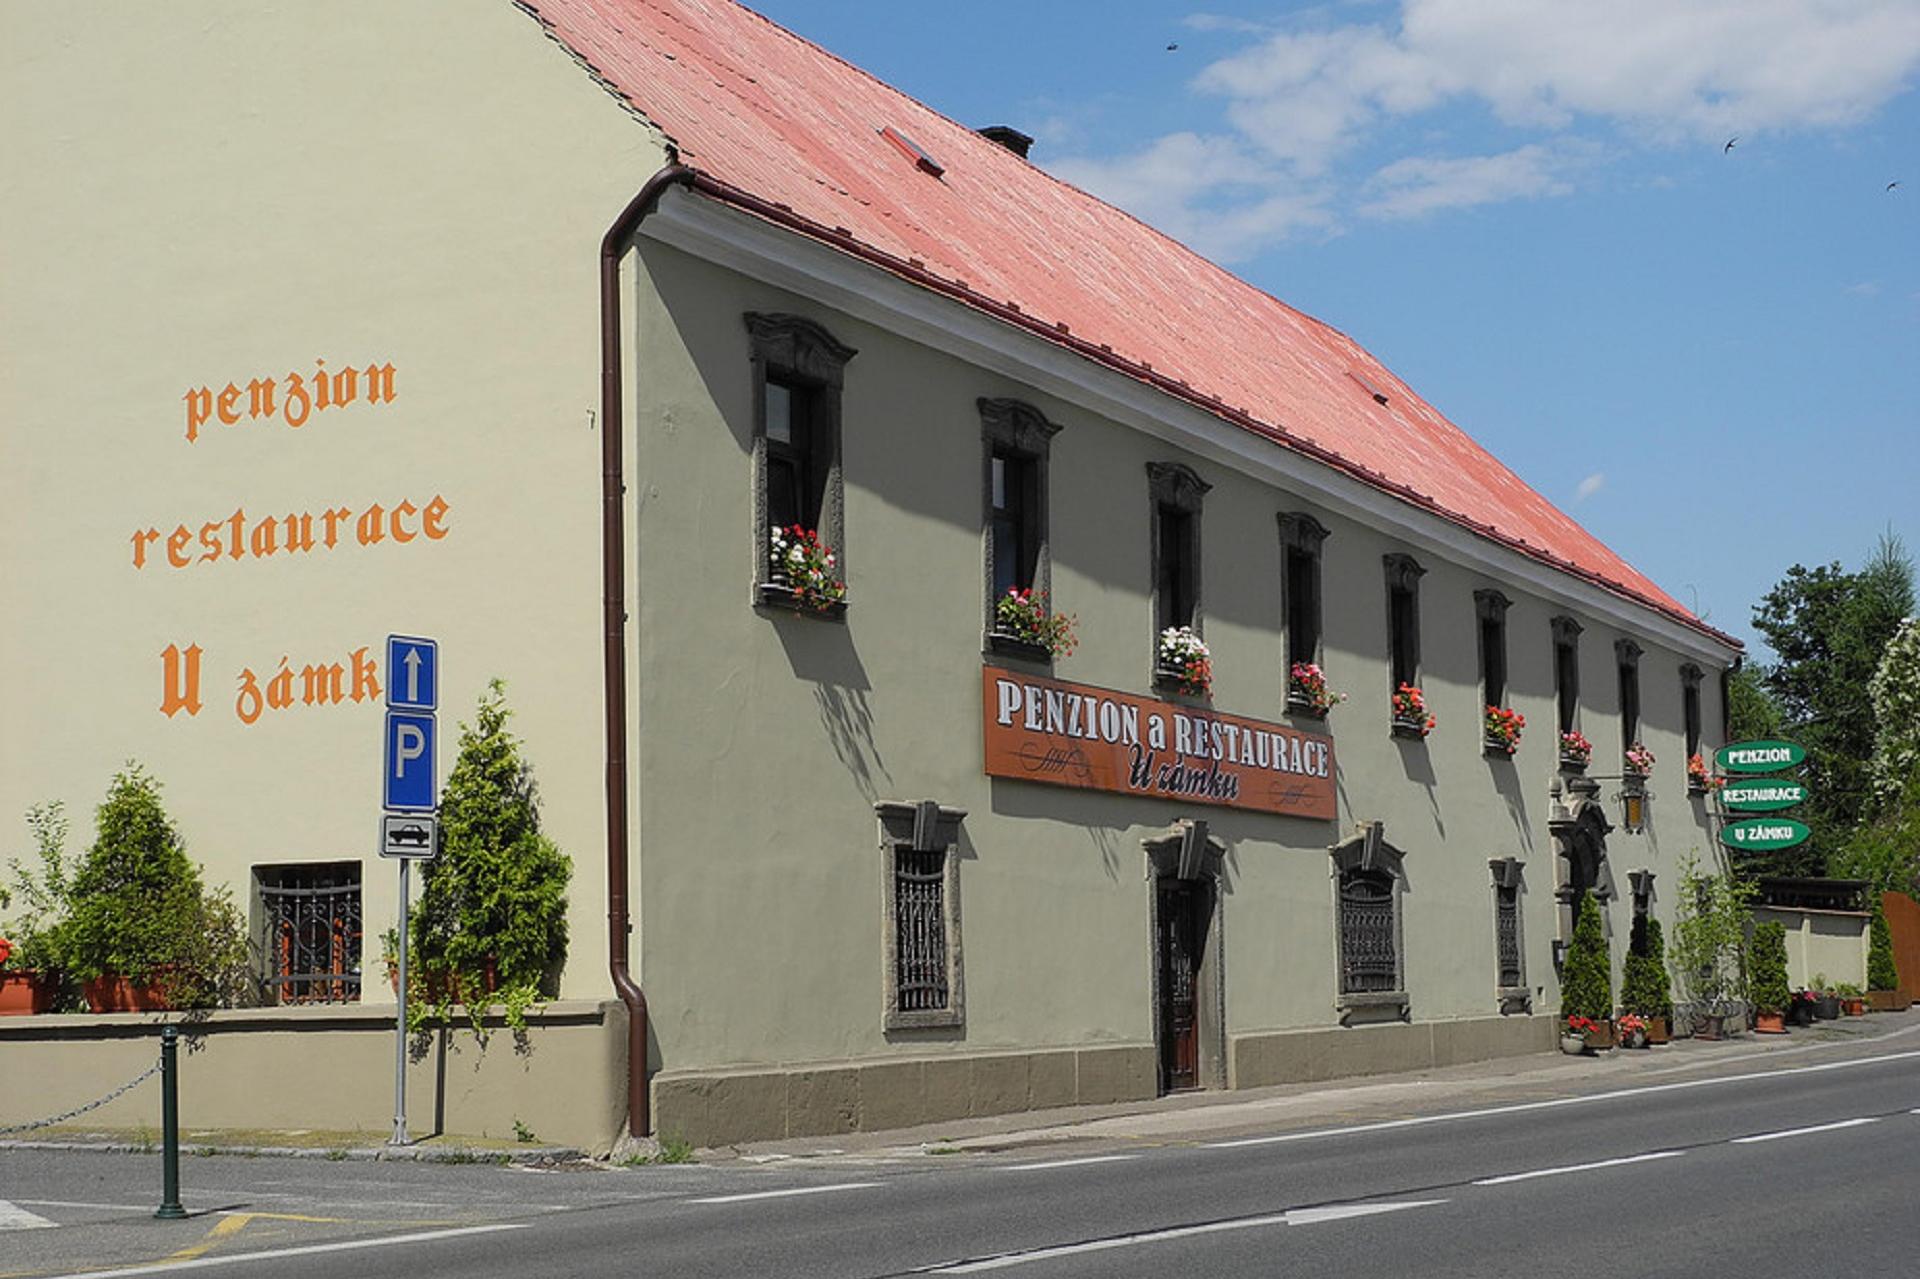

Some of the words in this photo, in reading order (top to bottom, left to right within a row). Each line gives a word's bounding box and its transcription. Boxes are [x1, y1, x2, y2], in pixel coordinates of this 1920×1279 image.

[183, 358, 398, 444] penzion
[130, 494, 450, 570] restaurace
[159, 642, 203, 719] U
[236, 646, 383, 724] zámk
[396, 724, 425, 778] P
[996, 679, 1139, 746] PENZION
[1149, 714, 1167, 750] a
[1174, 713, 1329, 778] RESTAURACE
[1728, 748, 1791, 764] PENZION
[1128, 742, 1154, 790] U
[1156, 753, 1239, 800] zámku
[1723, 787, 1801, 802] RESTAURACE
[1734, 828, 1745, 842] U
[1748, 824, 1793, 840] ZÁMKU
